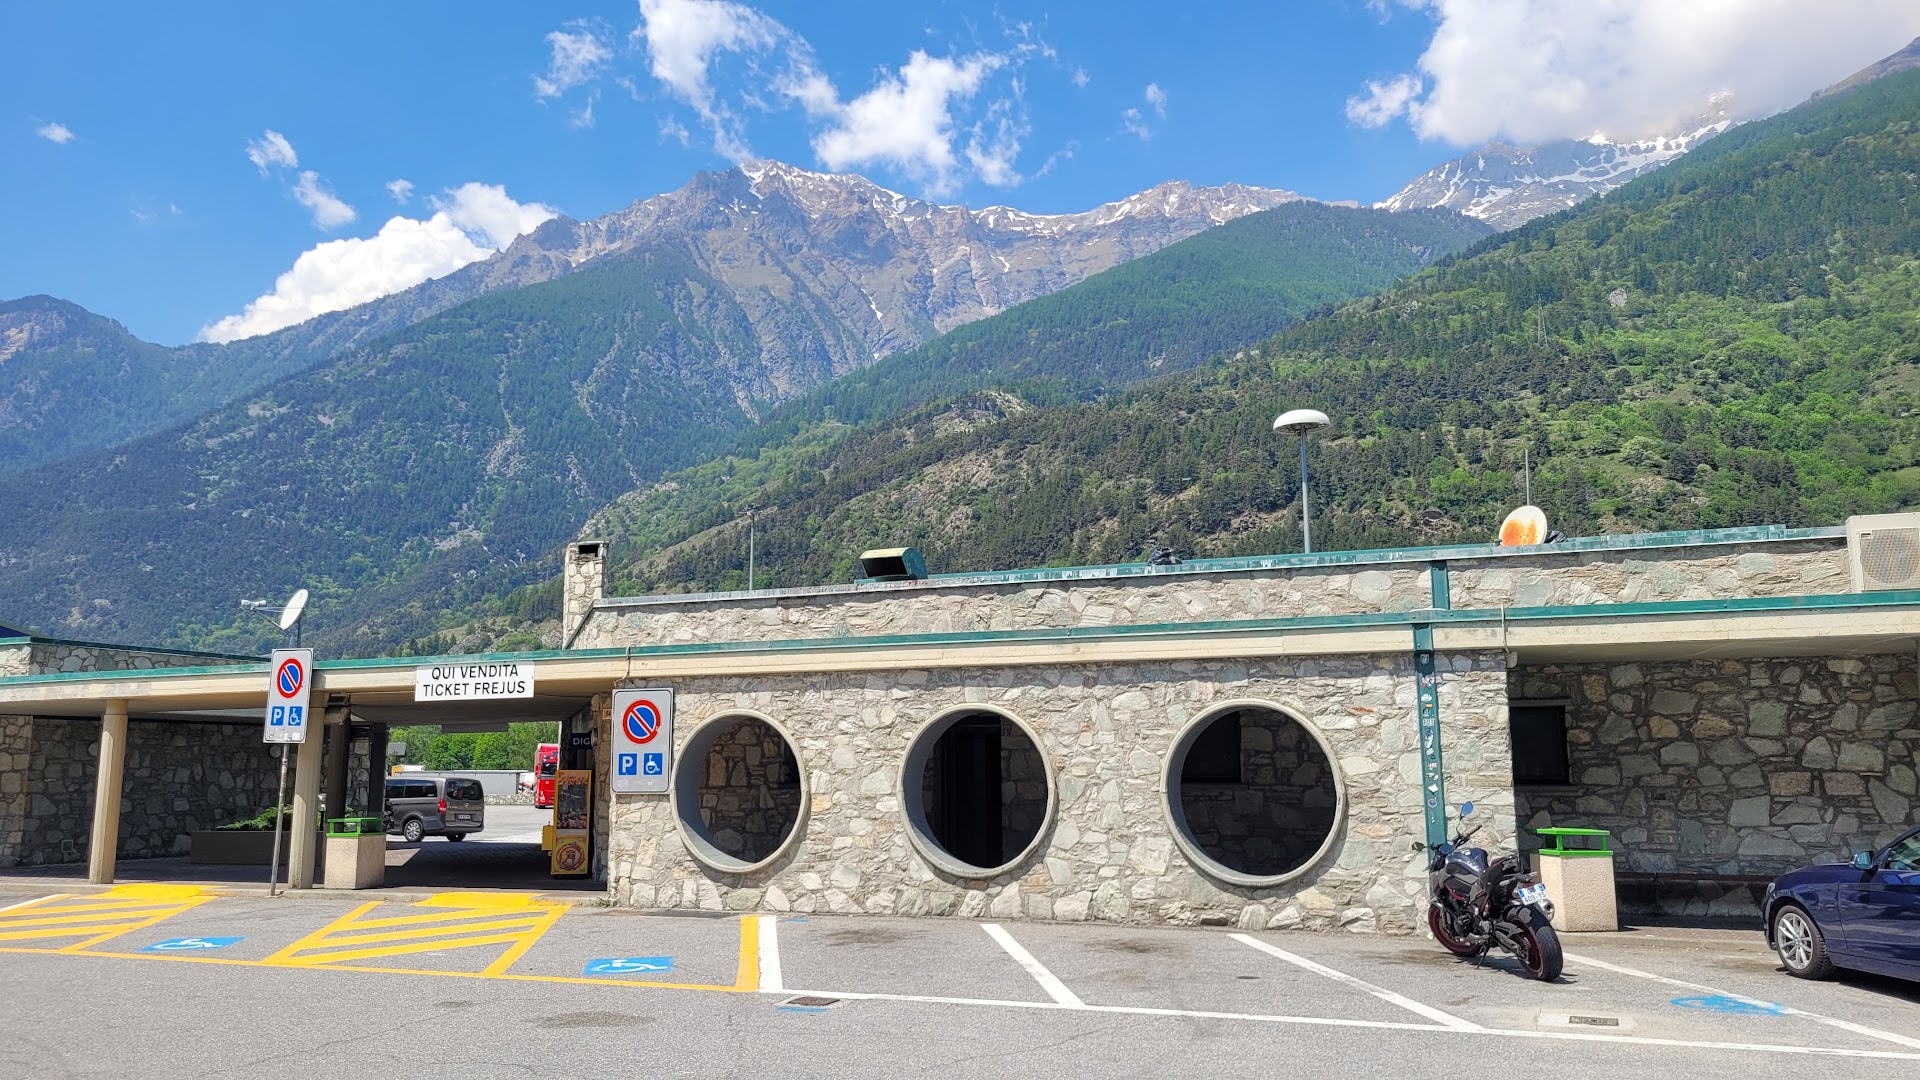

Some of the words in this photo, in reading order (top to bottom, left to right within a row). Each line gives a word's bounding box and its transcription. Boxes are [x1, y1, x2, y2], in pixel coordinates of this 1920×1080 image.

[431, 667, 455, 680] QUI
[460, 664, 518, 678] VENDITA
[423, 683, 469, 697] TICKET
[474, 681, 525, 695] FREJUS
[273, 708, 282, 724] P
[622, 755, 634, 773] P
